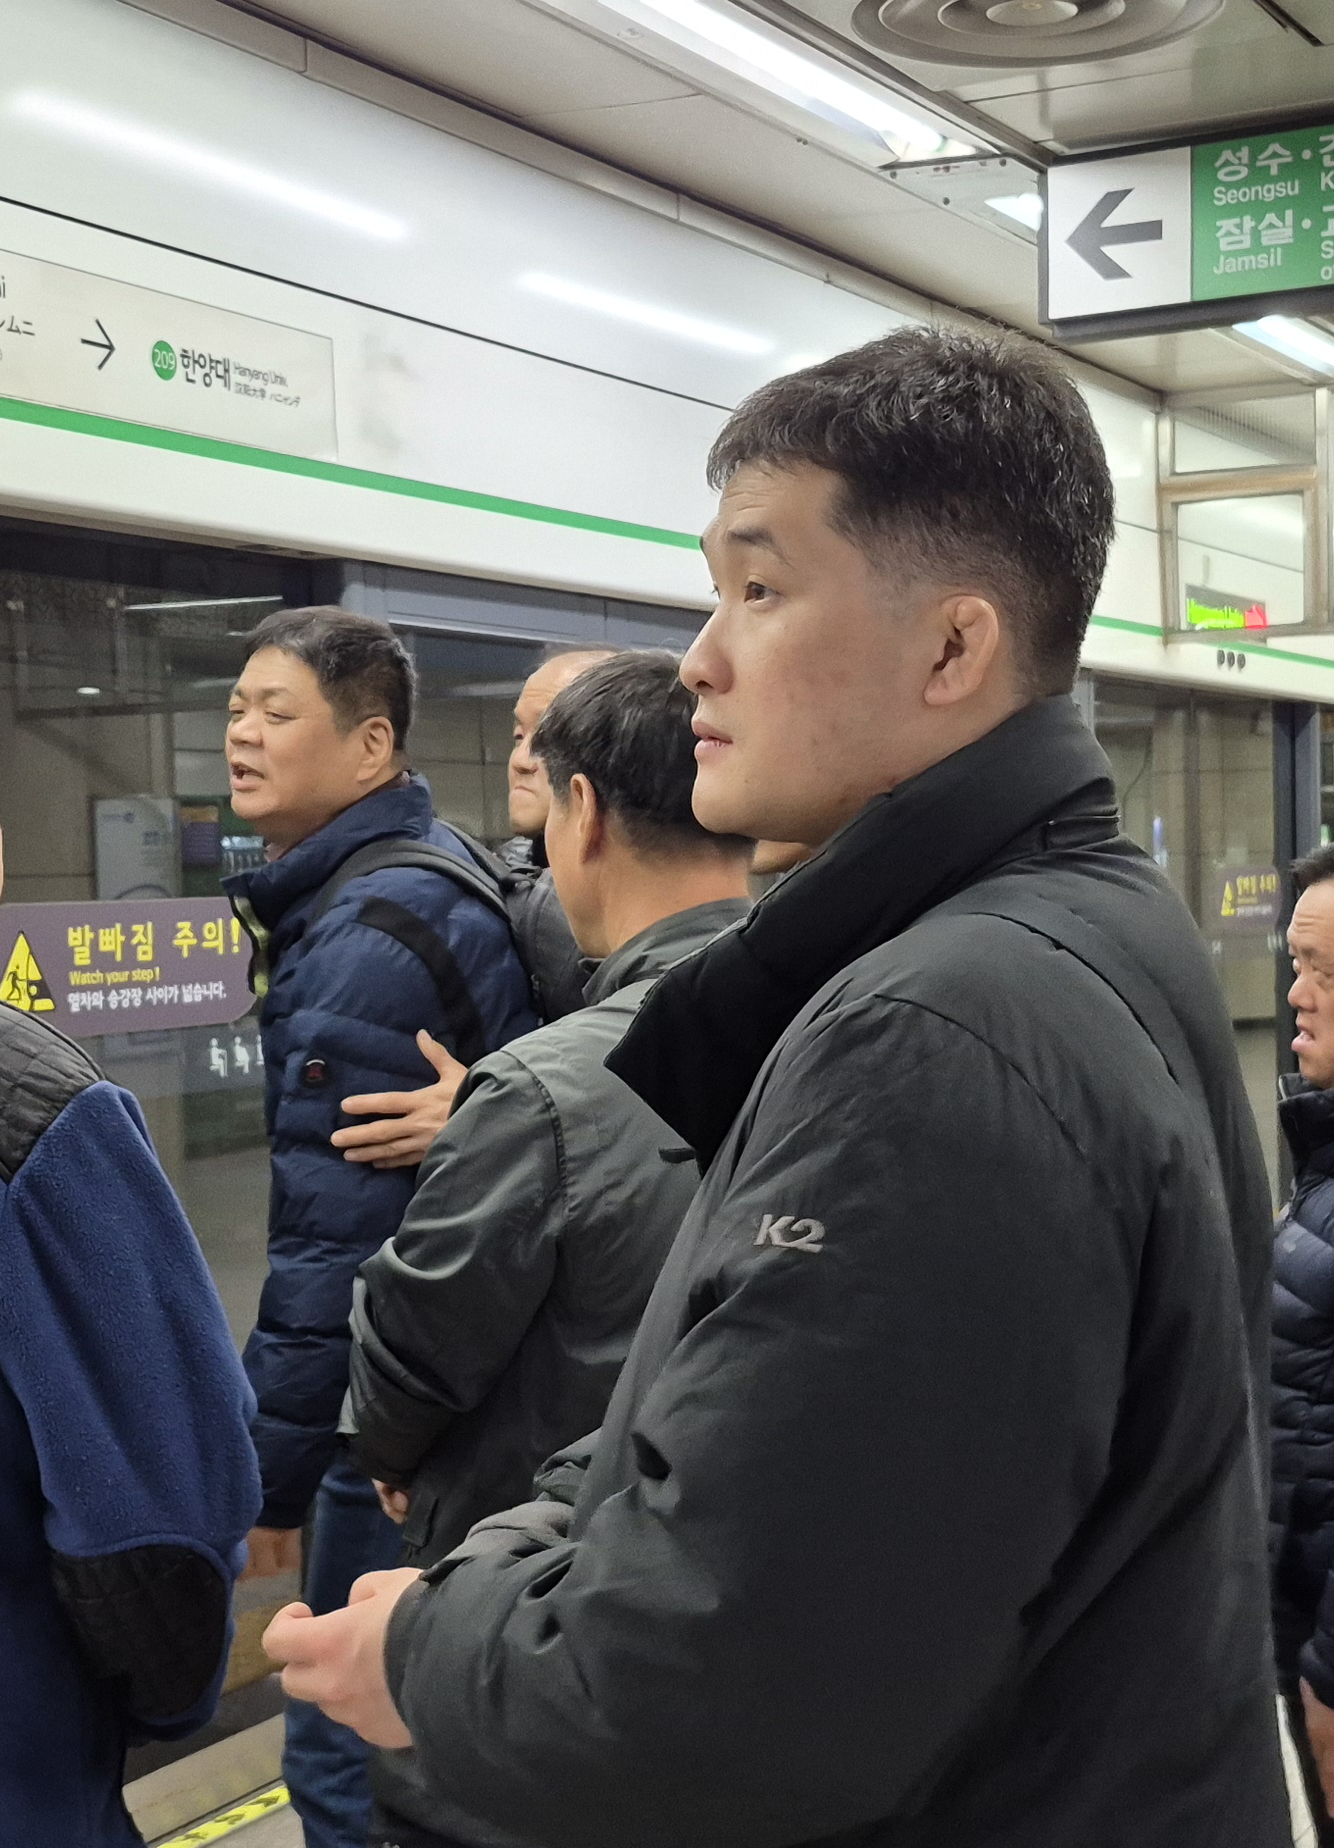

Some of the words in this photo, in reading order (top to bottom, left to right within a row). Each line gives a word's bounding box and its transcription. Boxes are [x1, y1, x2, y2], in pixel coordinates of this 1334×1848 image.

[1213, 179, 1299, 206] Seongsu
[1213, 247, 1282, 275] Jamsil
[153, 348, 176, 371] 209
[180, 348, 230, 391] 한양대
[68, 921, 154, 966] 발빠짐
[172, 917, 241, 959] 주의!
[69, 969, 104, 986] Watch
[107, 970, 130, 986] your
[145, 985, 179, 1006] 사이가
[753, 1213, 826, 1253] K2
